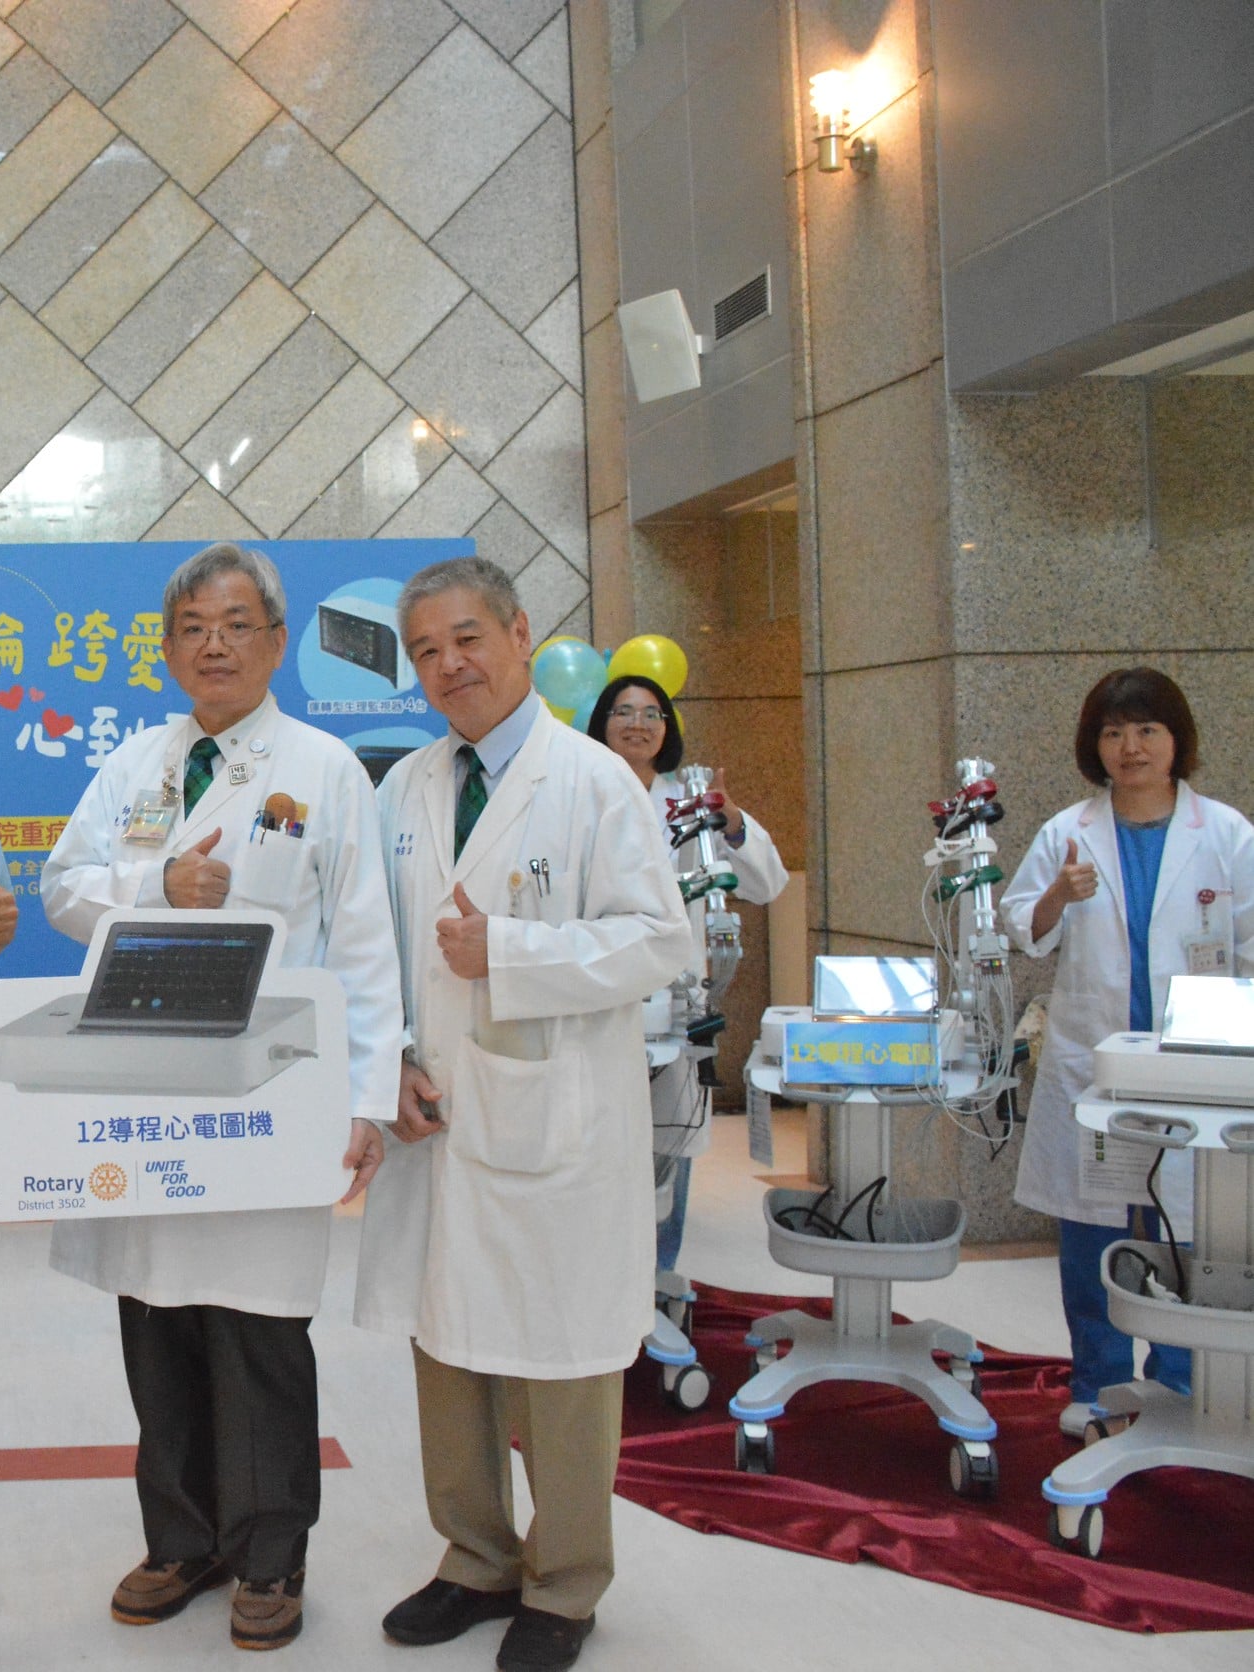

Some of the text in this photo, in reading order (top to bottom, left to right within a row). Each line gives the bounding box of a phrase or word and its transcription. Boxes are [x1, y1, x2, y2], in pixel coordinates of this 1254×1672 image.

[76, 1110, 274, 1143] 12導程心電圖機
[145, 1160, 185, 1173] UNITE
[23, 1176, 84, 1194] Rotary
[161, 1173, 189, 1185] FOR
[165, 1185, 206, 1198] GOOD
[18, 1197, 86, 1211] District 3502
